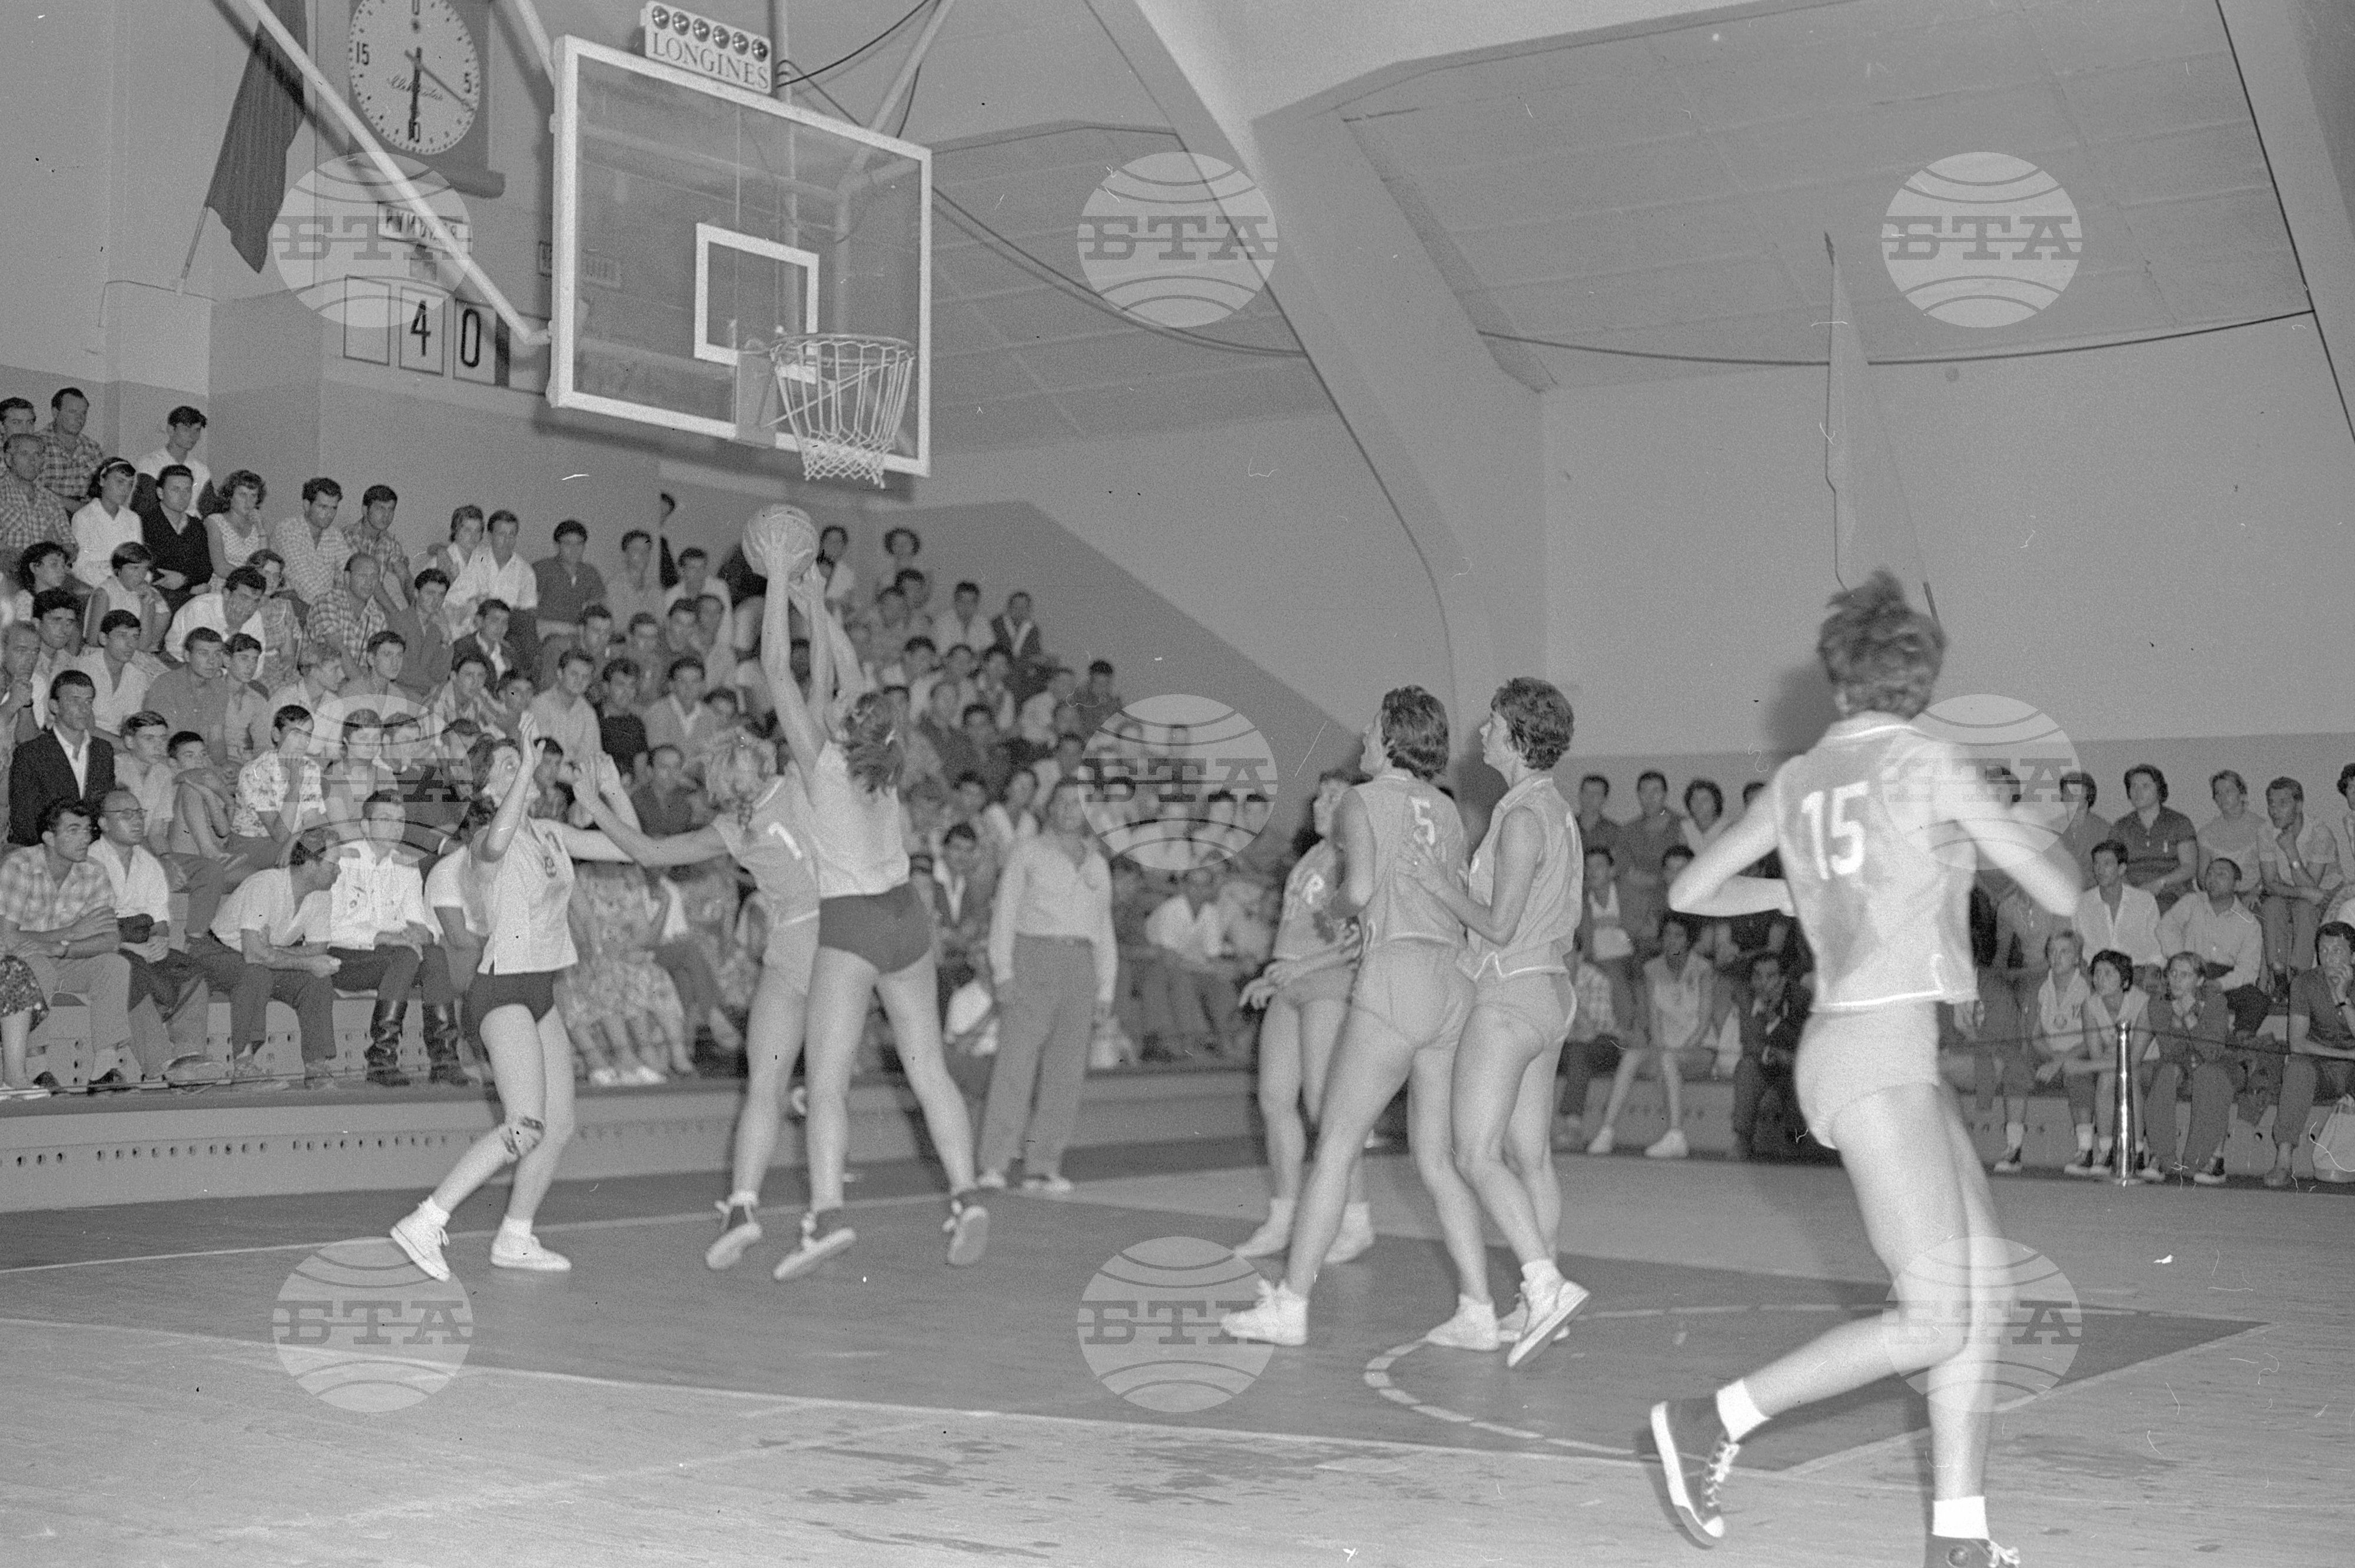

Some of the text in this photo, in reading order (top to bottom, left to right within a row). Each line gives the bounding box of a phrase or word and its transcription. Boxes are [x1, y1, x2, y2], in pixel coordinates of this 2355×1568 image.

[356, 41, 370, 65] 15
[654, 32, 768, 89] LONGINES
[1408, 796, 1435, 846] 5
[1802, 781, 1869, 879] 15
